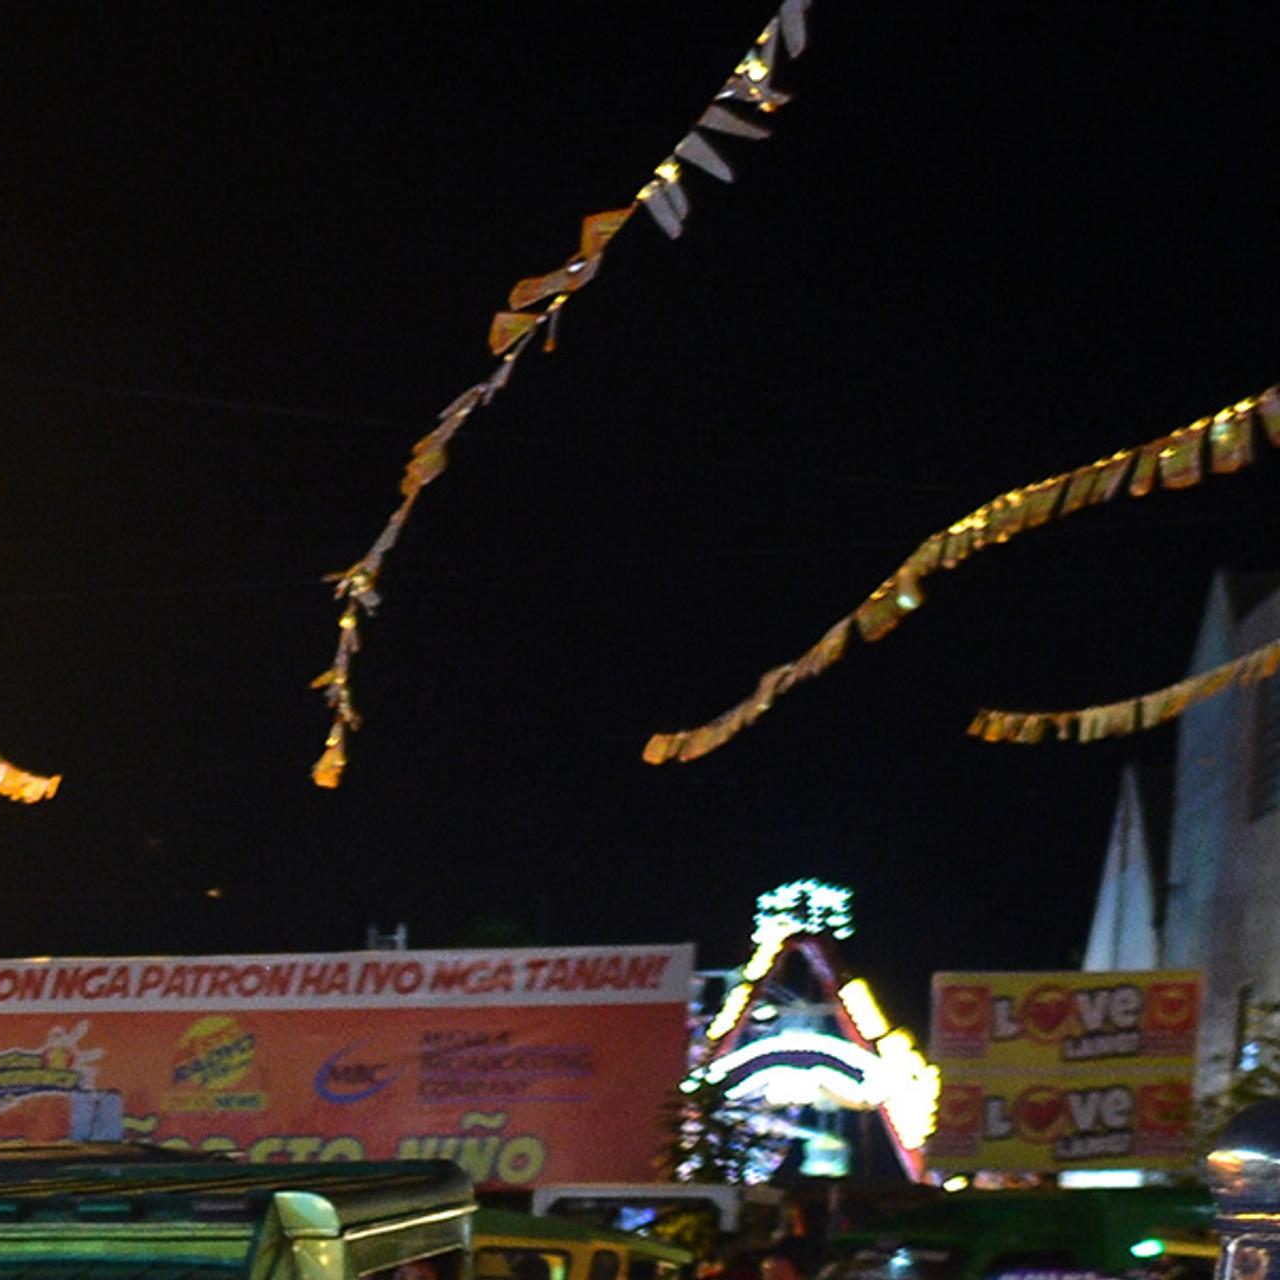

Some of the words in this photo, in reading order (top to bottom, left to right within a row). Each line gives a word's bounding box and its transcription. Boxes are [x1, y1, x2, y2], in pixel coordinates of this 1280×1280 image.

[53, 966, 128, 1001] NGA
[135, 964, 299, 999] PATRON
[299, 963, 357, 997] HA
[357, 961, 424, 996] IYO
[430, 960, 512, 995] NGA
[521, 955, 670, 993] TANAN!
